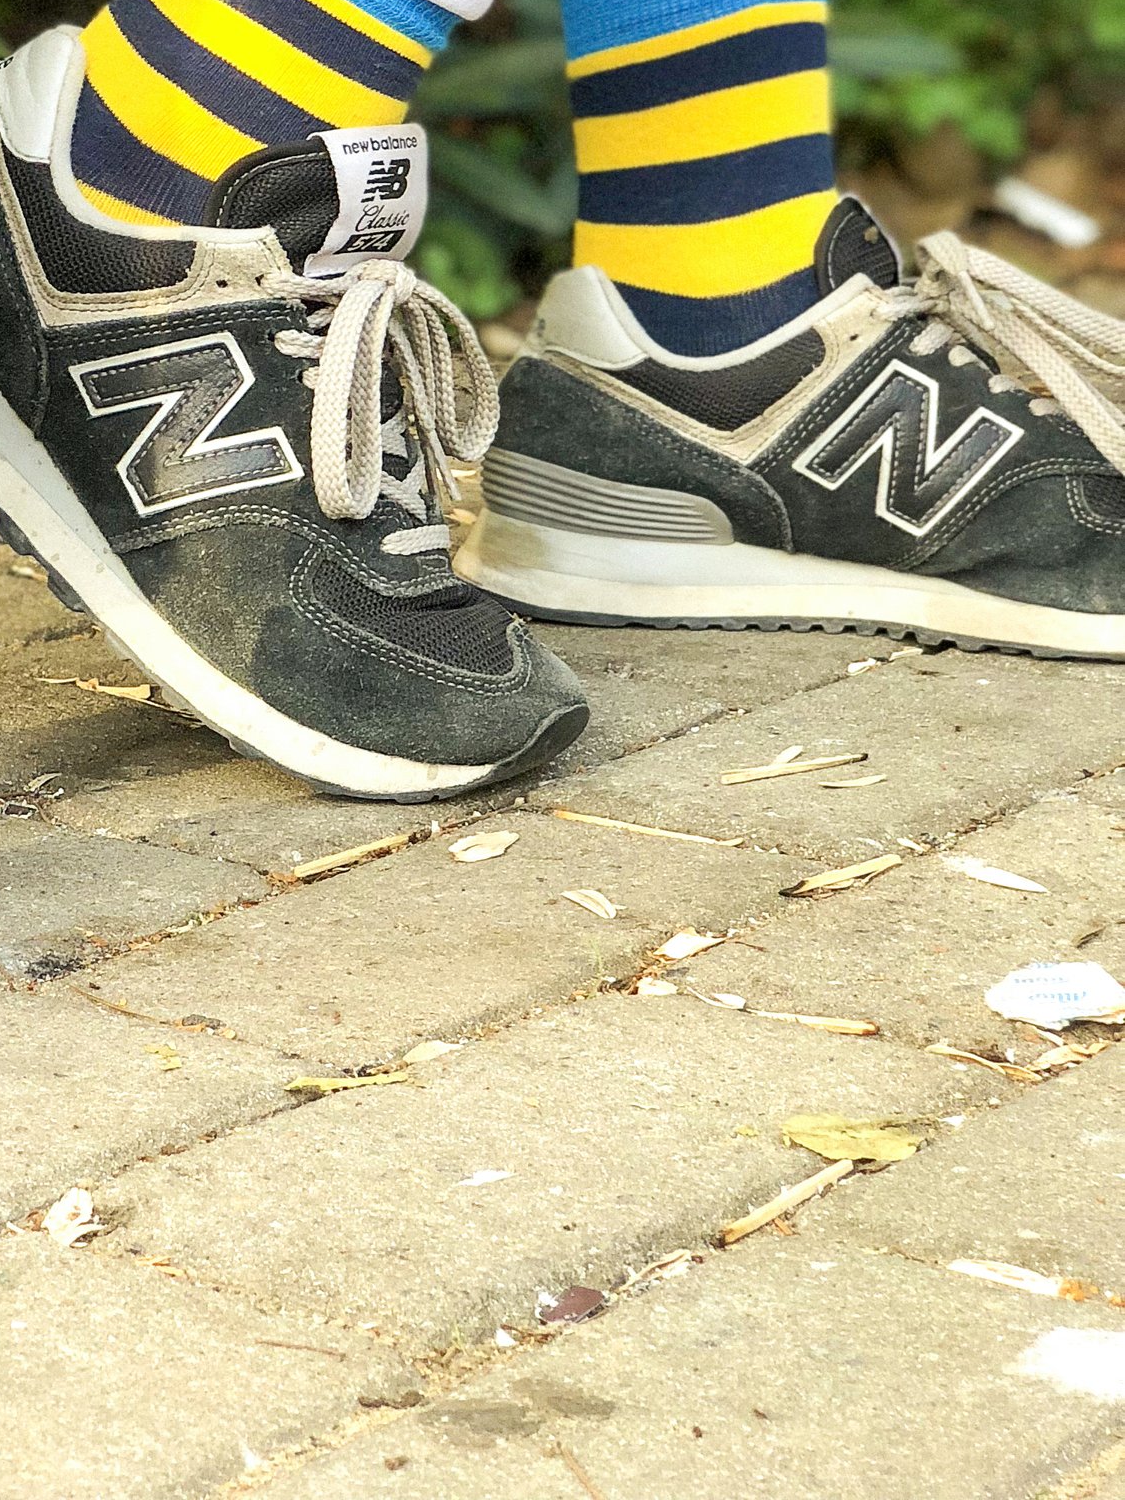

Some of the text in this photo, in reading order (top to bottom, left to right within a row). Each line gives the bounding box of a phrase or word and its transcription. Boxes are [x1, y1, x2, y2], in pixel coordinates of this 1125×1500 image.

[355, 204, 410, 232] Classic
[347, 232, 395, 252] 574
[791, 358, 1025, 537] N
